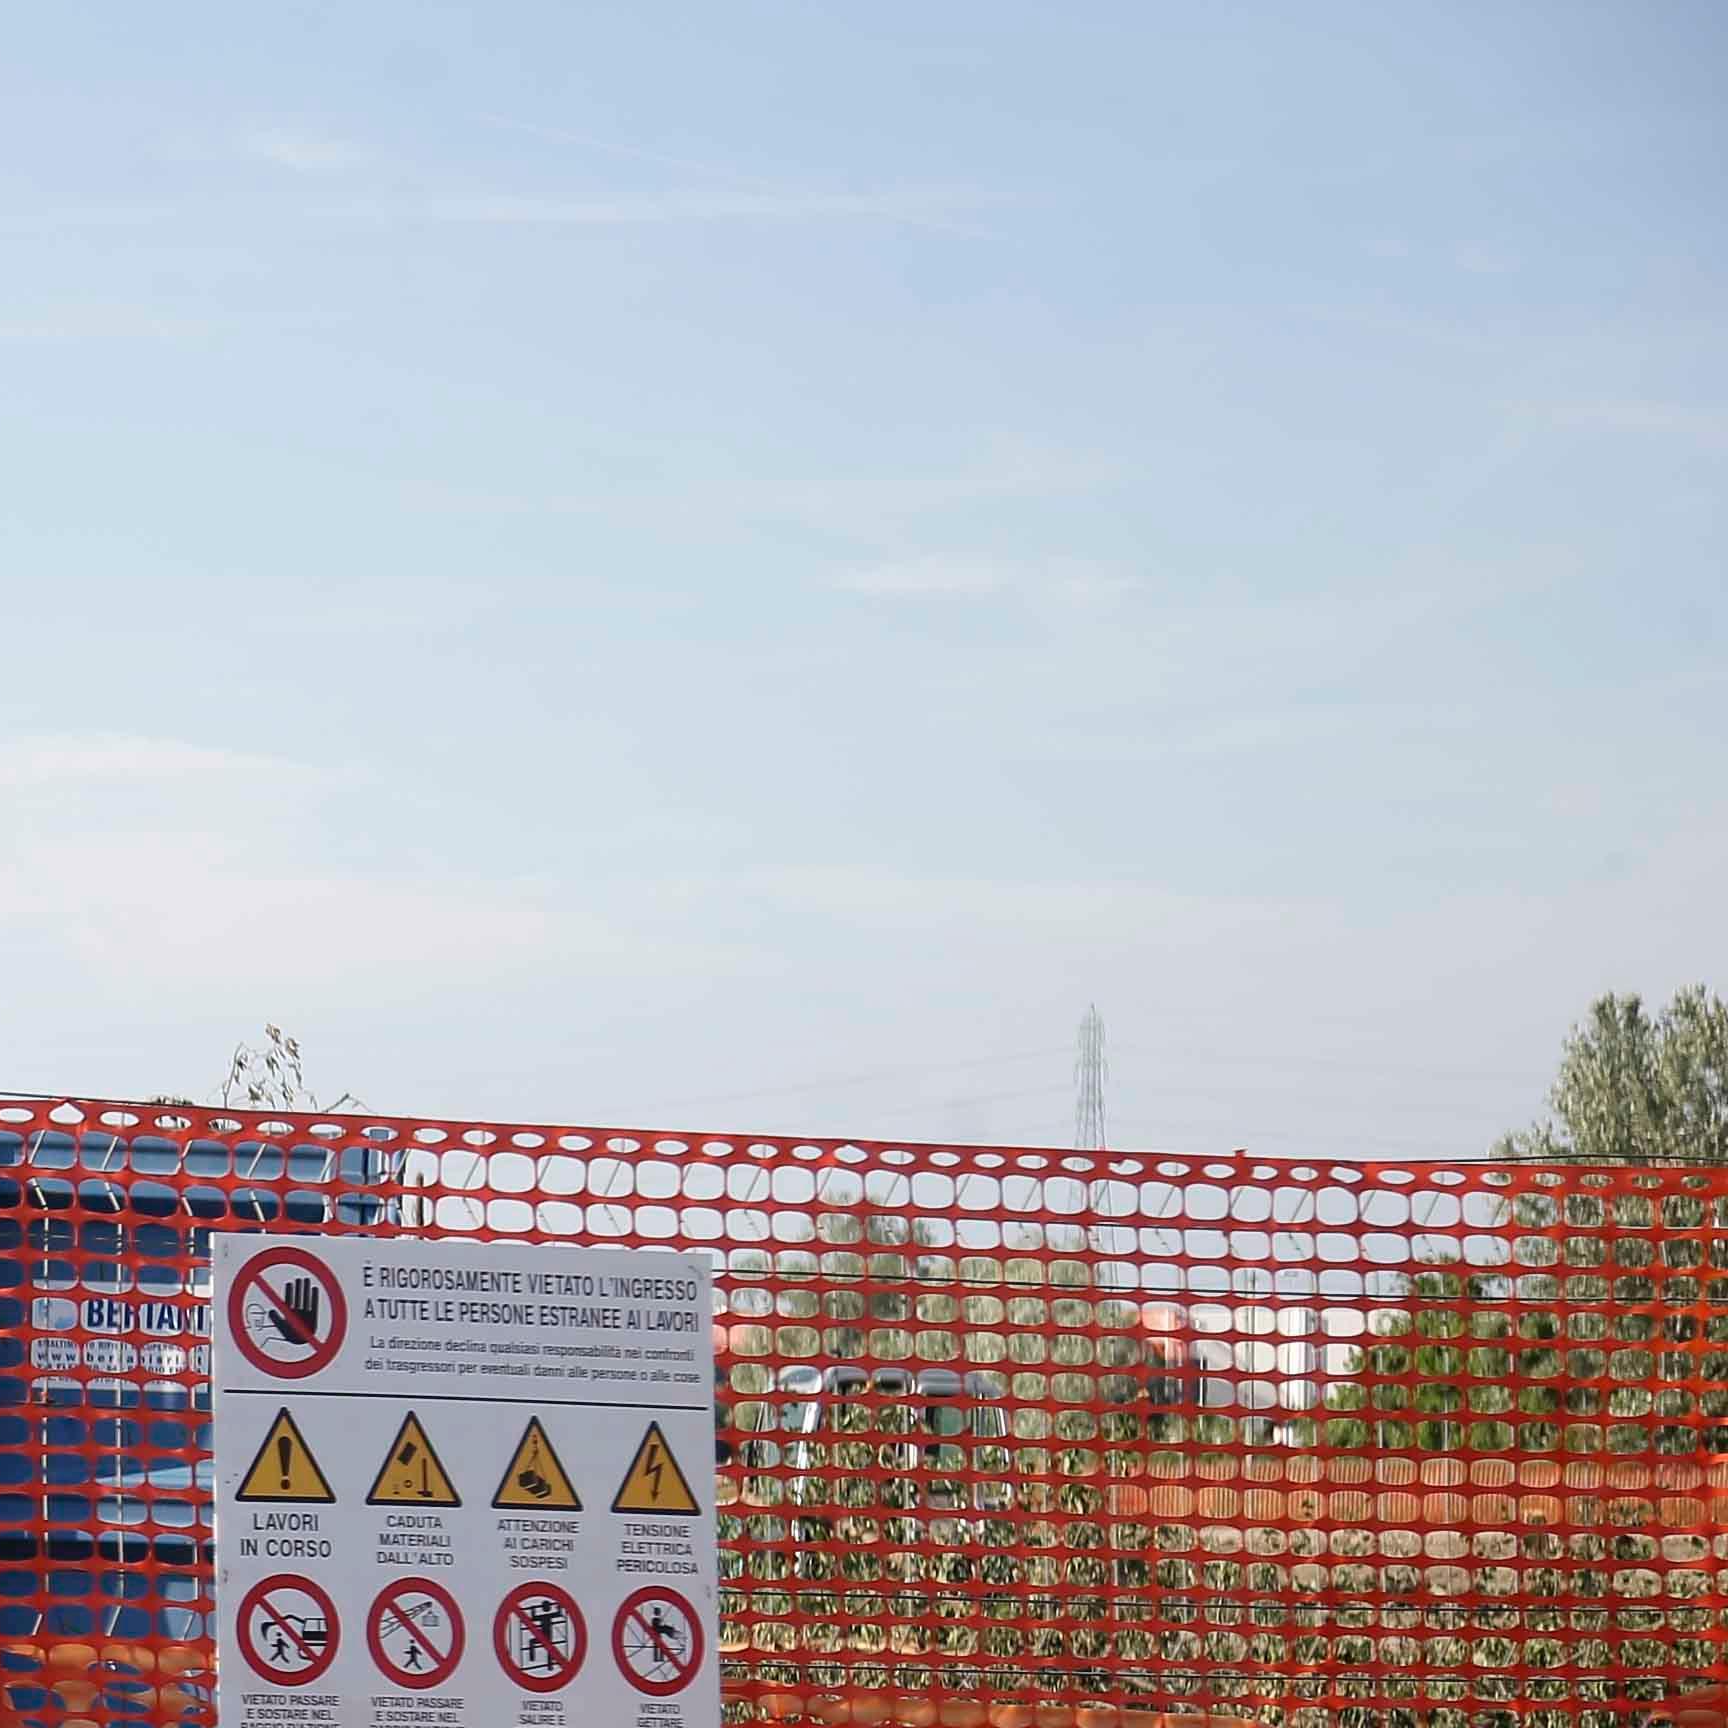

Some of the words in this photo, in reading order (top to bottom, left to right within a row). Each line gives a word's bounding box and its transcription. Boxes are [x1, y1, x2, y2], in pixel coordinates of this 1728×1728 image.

[379, 1268, 522, 1292] RIGOROSAMENTE
[527, 1275, 594, 1295] VIETATO
[599, 1278, 697, 1300] L'INGRESSO
[364, 1299, 375, 1318] A
[378, 1299, 430, 1320] TUTTE
[434, 1301, 454, 1321] LE
[459, 1303, 535, 1324] PERSONE
[538, 1306, 622, 1328] ESTRANEE
[626, 1310, 640, 1329] AI
[646, 1311, 699, 1331] LAVORI
[370, 1336, 385, 1348] La
[388, 1340, 441, 1350] direzione
[444, 1342, 487, 1352] declina
[490, 1344, 540, 1354] qualsiasi
[624, 1350, 642, 1358] nei
[645, 1351, 694, 1360] confronti
[365, 1358, 383, 1369] dei
[386, 1361, 455, 1372] trasgressori
[458, 1364, 478, 1373] per
[480, 1365, 530, 1375] eventuali
[533, 1367, 565, 1376] danni
[567, 1367, 588, 1378] alle
[591, 1370, 637, 1380] persone
[650, 1370, 671, 1381] alle
[674, 1374, 701, 1383] cose
[253, 1514, 318, 1531] LAVORI
[386, 1516, 443, 1528] CADUTA
[497, 1519, 580, 1533] ATTENZIONE
[624, 1524, 691, 1537] TENSIONE
[379, 1534, 451, 1547] MATERIALI
[504, 1537, 517, 1549] AI
[520, 1538, 574, 1551] CARICHI
[240, 1539, 258, 1556] IN
[265, 1540, 331, 1557] CORSO
[622, 1542, 693, 1555] ELETTRICA
[376, 1552, 454, 1565] DALL'ALTO
[510, 1556, 568, 1568] SOSPESI
[616, 1560, 699, 1573] PERICOLOSA
[242, 1694, 287, 1705] VIETATO
[288, 1695, 340, 1706] PASSARE
[371, 1697, 414, 1707] VIETATO
[416, 1698, 464, 1708] PASSARE
[522, 1701, 563, 1711] VIETATO
[257, 1709, 309, 1719] SOSTARE
[310, 1710, 335, 1720] NEL
[640, 1704, 680, 1714] VIETATO
[384, 1711, 437, 1722] SOSTARE
[436, 1712, 459, 1723] NEL
[519, 1715, 556, 1725] SALIRE
[636, 1717, 684, 1728] GETTARE
